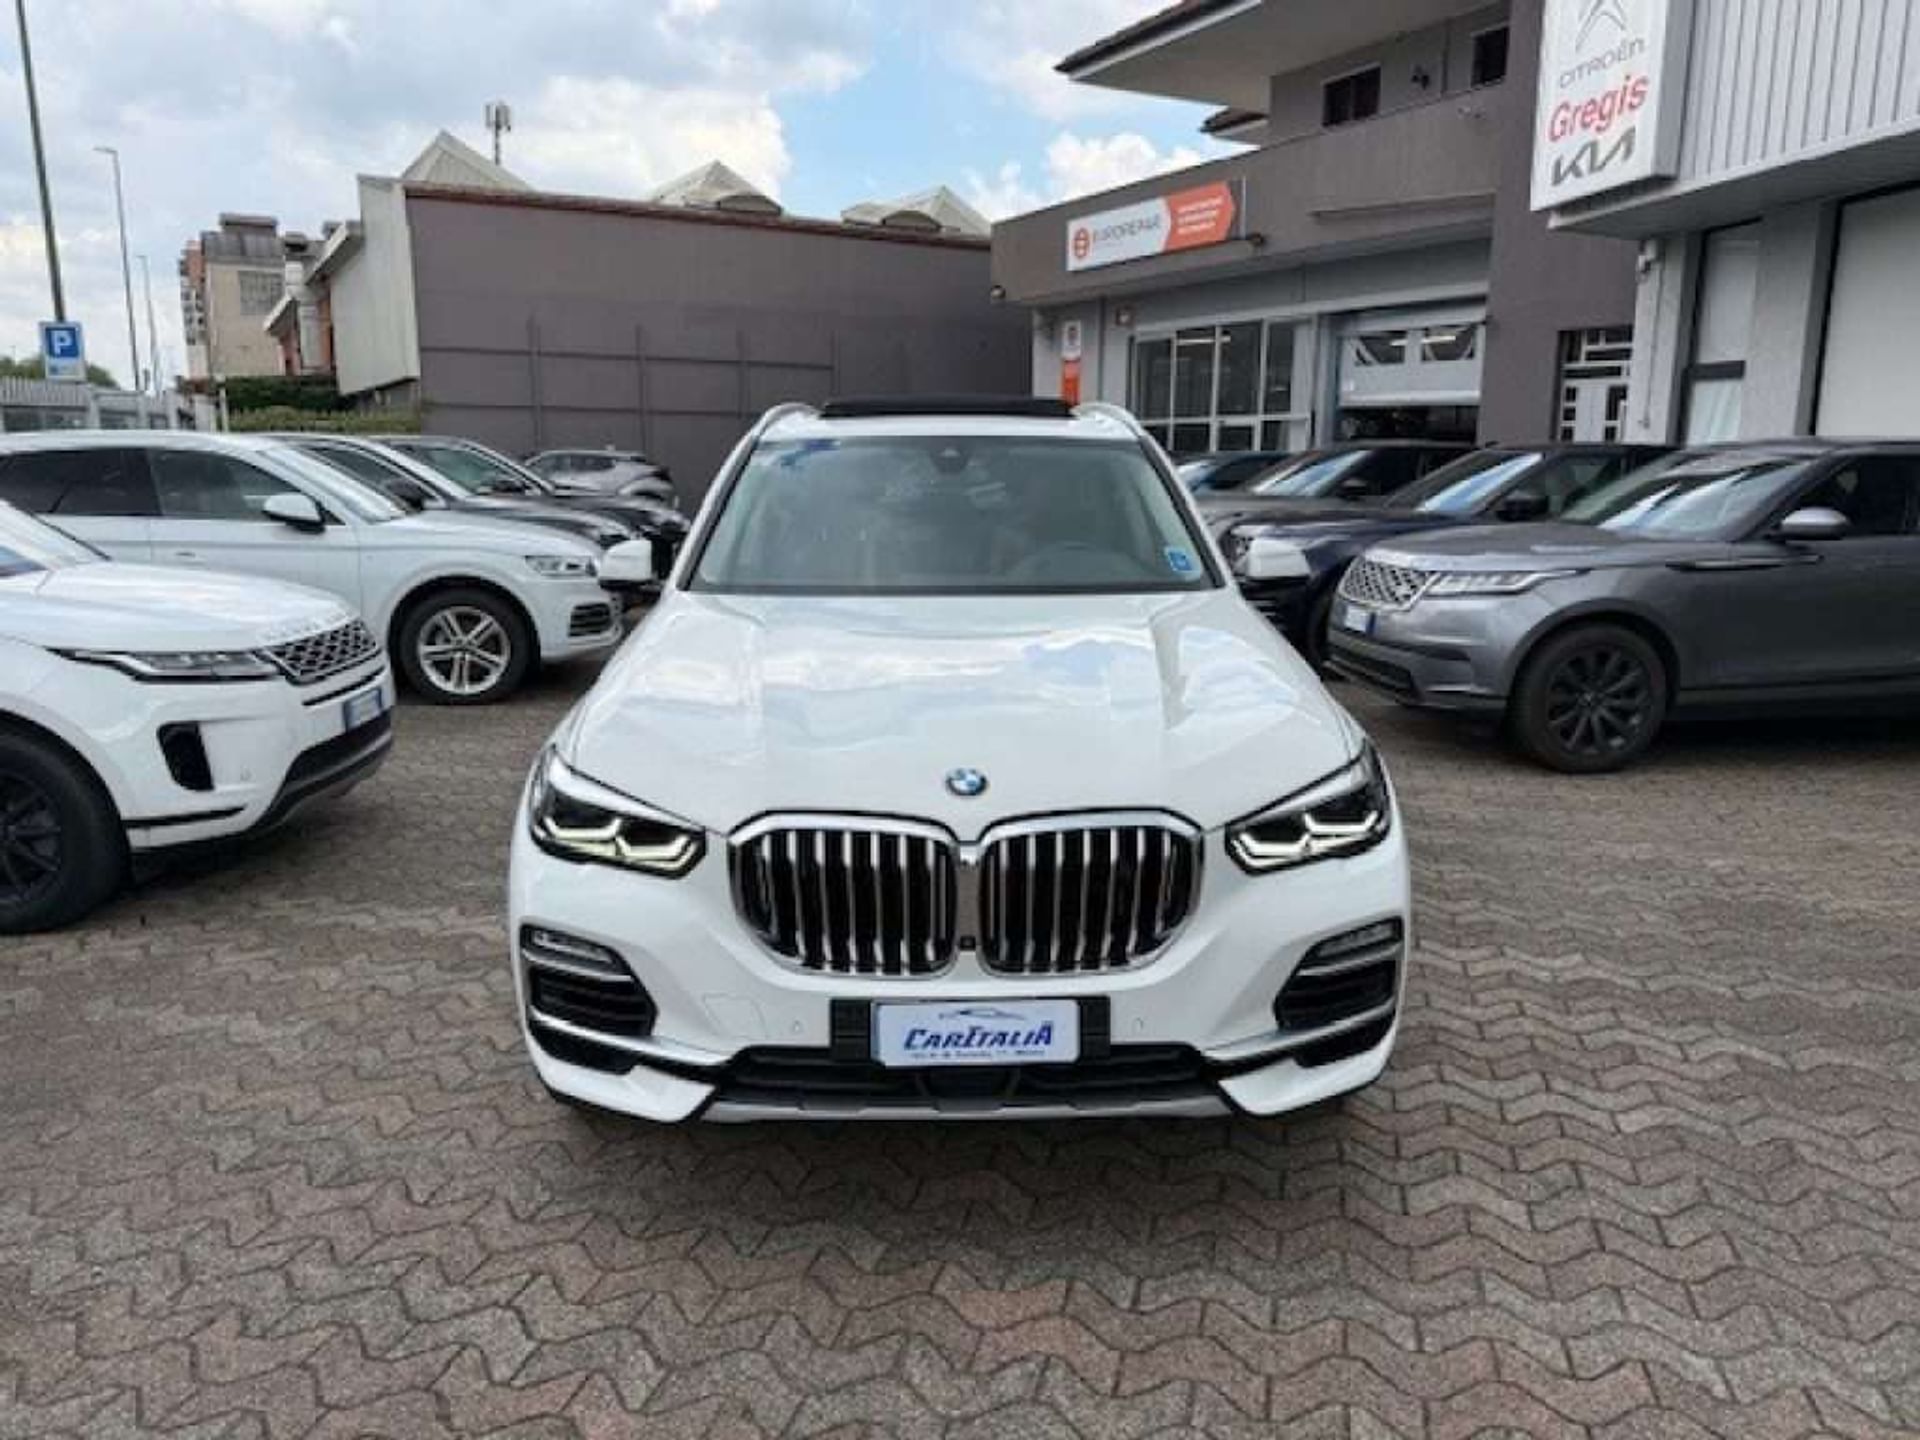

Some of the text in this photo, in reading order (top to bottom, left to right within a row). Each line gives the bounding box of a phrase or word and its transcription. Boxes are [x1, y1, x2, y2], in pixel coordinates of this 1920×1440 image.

[1549, 74, 1648, 142] Gregis
[1552, 126, 1636, 187] KIA
[51, 330, 73, 355] P
